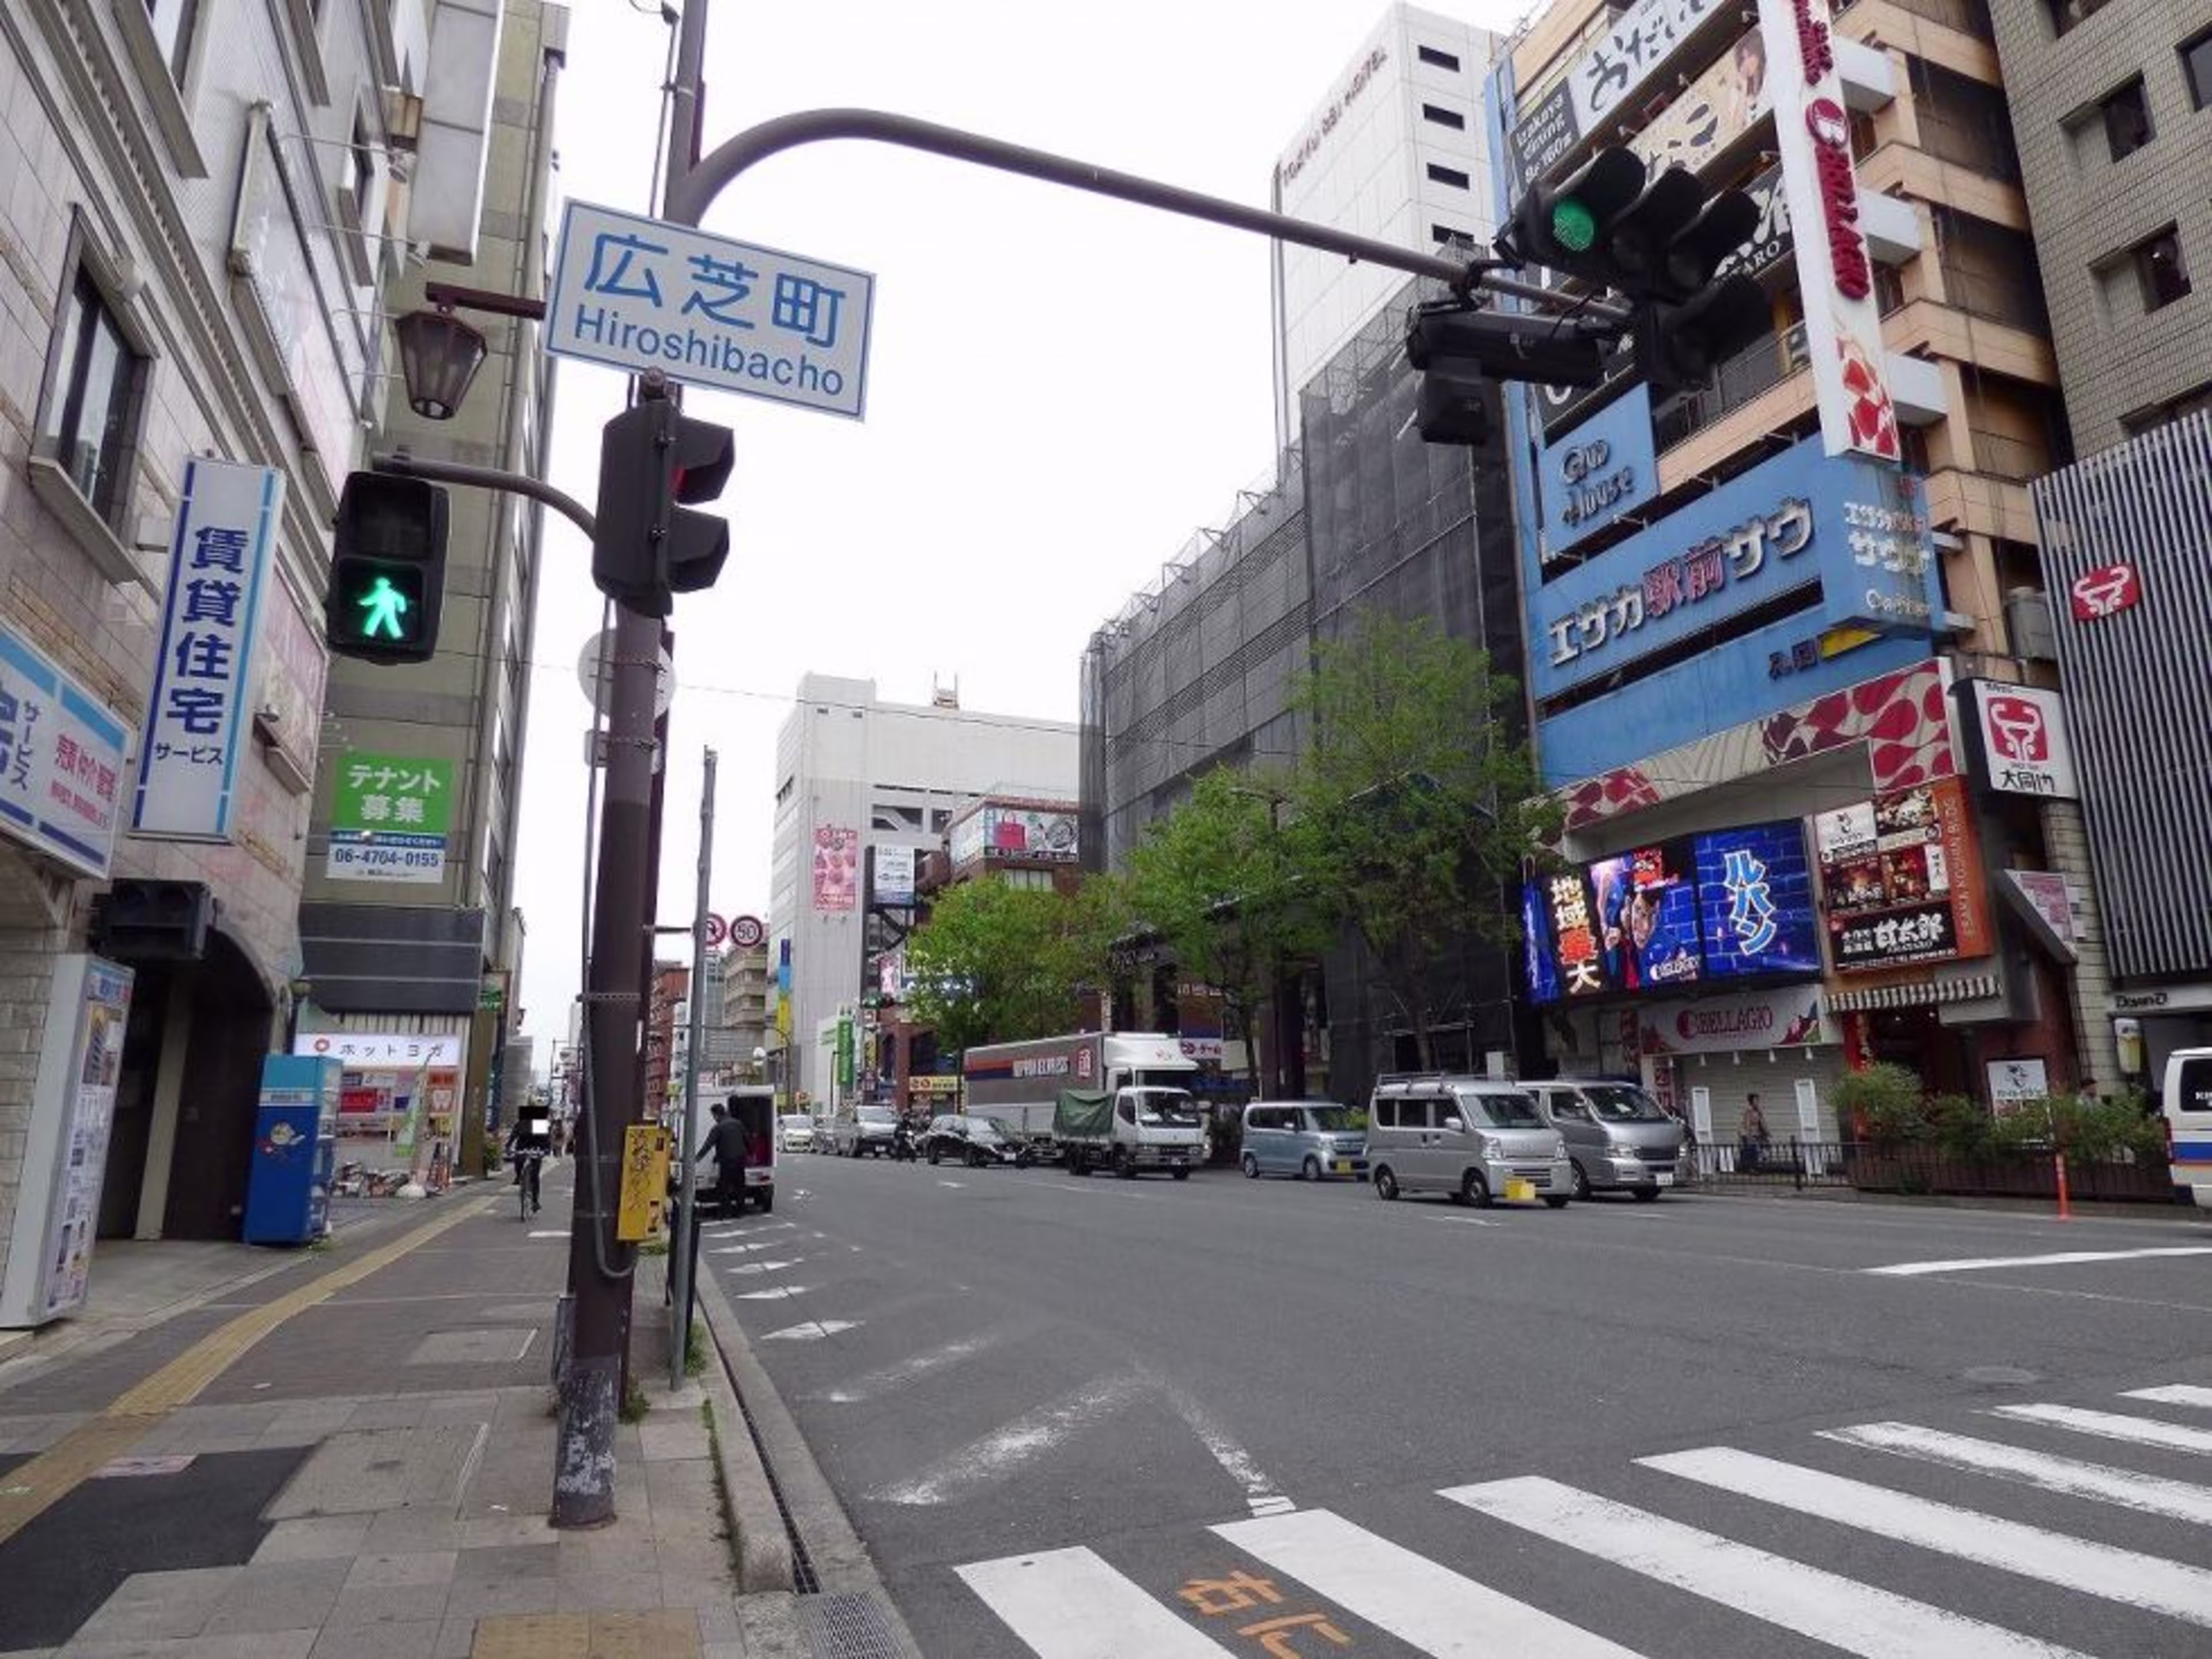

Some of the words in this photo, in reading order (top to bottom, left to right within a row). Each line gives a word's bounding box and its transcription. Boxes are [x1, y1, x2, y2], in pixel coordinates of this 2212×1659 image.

[1344, 46, 1388, 107] HOTEL
[584, 233, 846, 347] 広芝町
[575, 304, 844, 396] Hiroshibacho
[1550, 495, 1815, 667] エサカ駅前サウ
[166, 524, 249, 735] 賃貸住宅
[10, 700, 40, 791] サービス
[156, 744, 224, 766] サービス
[349, 764, 442, 795] テナント
[361, 794, 424, 824] 募集
[737, 923, 757, 940] 50
[1550, 876, 1602, 995] 地域最大
[1724, 849, 1778, 956] ルパン
[1873, 913, 1945, 949] 甘太郎
[340, 1044, 444, 1057] ホットヨガ
